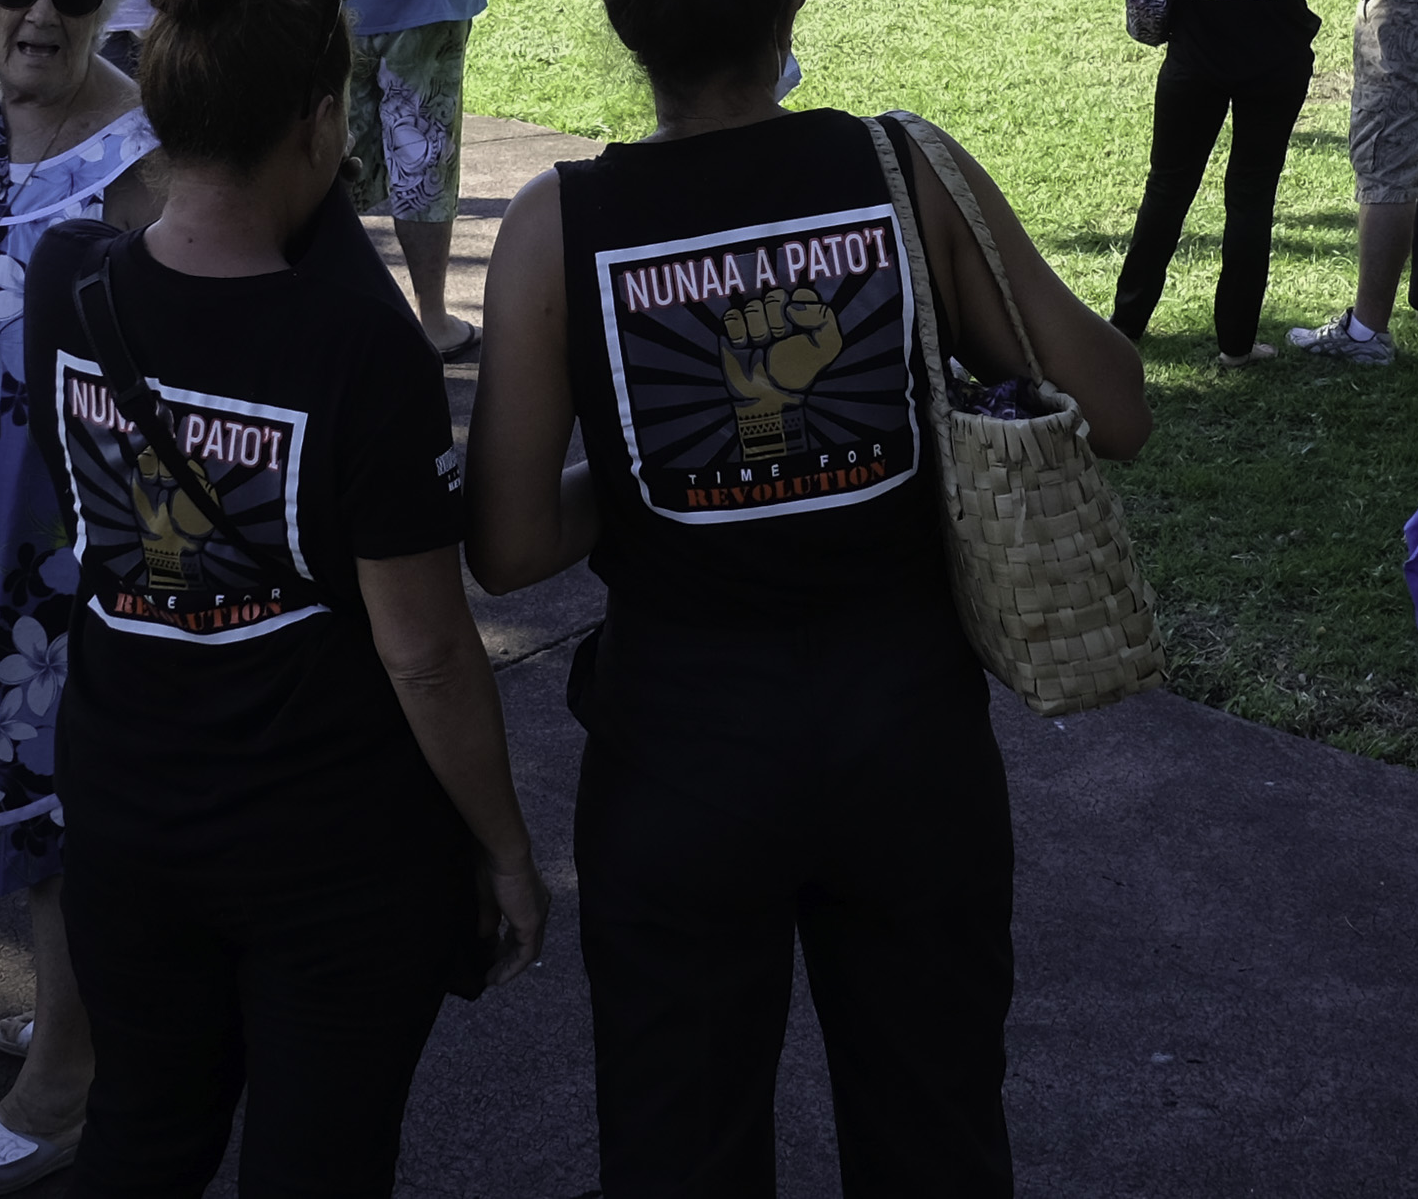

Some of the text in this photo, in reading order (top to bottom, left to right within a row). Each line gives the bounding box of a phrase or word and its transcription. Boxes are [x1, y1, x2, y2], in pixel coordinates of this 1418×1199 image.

[624, 229, 890, 312] NUNAA A PATO'I
[185, 413, 283, 471] PATO'I
[688, 443, 882, 485] TIME FOR
[685, 459, 887, 508] REVOLUTION
